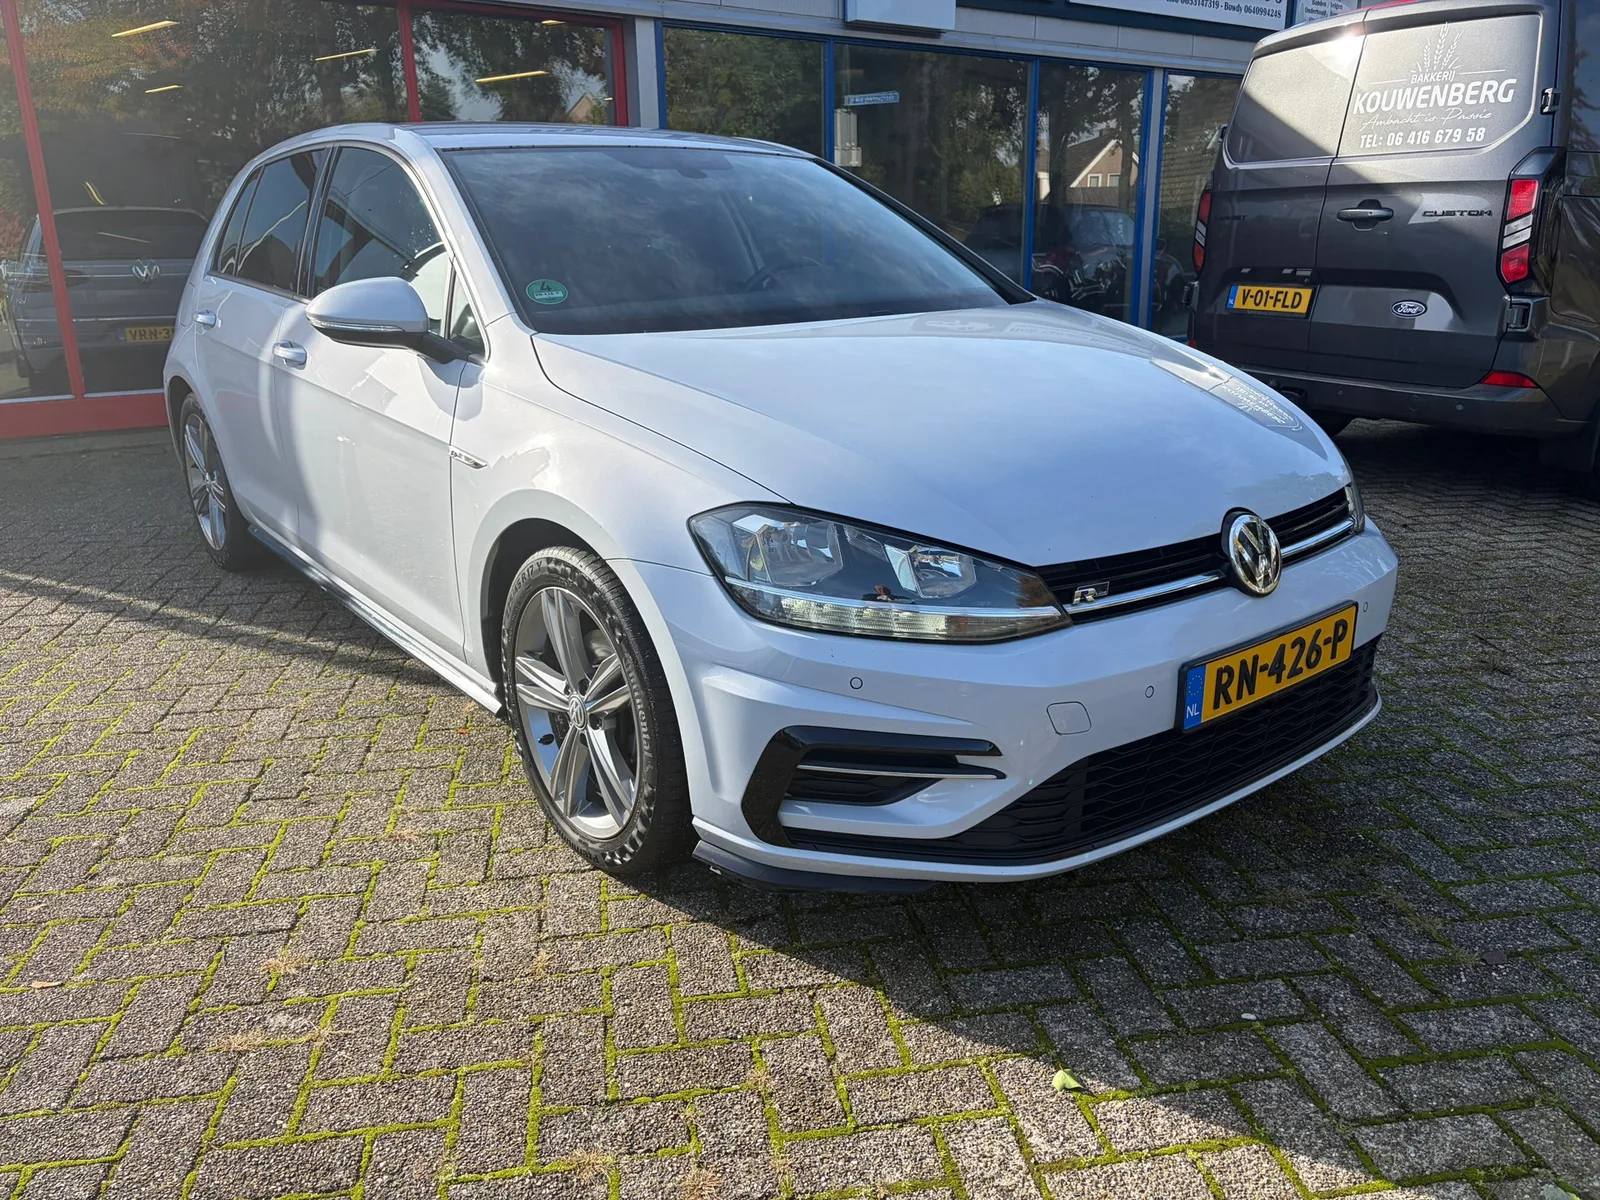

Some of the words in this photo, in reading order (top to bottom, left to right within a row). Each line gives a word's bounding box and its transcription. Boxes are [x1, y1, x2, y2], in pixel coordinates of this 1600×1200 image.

[1410, 71, 1456, 84] BAKKERIJ
[1353, 79, 1517, 115] KOUWENBERG
[1360, 113, 1425, 131] Ambacht
[1425, 113, 1437, 122] is
[1441, 108, 1492, 125] Passie
[1360, 134, 1383, 148] TEL:
[1387, 132, 1403, 147] 06
[1407, 130, 1430, 145] 416
[1435, 128, 1462, 143] 679
[1466, 127, 1486, 142] 58
[1422, 209, 1493, 217] CUSTOM
[539, 280, 552, 291] 4
[1242, 289, 1302, 309] V-01-FLD
[1397, 303, 1420, 314] Ford
[128, 327, 174, 341] VRN-3
[1213, 618, 1348, 710] RN-426-P
[1186, 703, 1200, 719] NL
